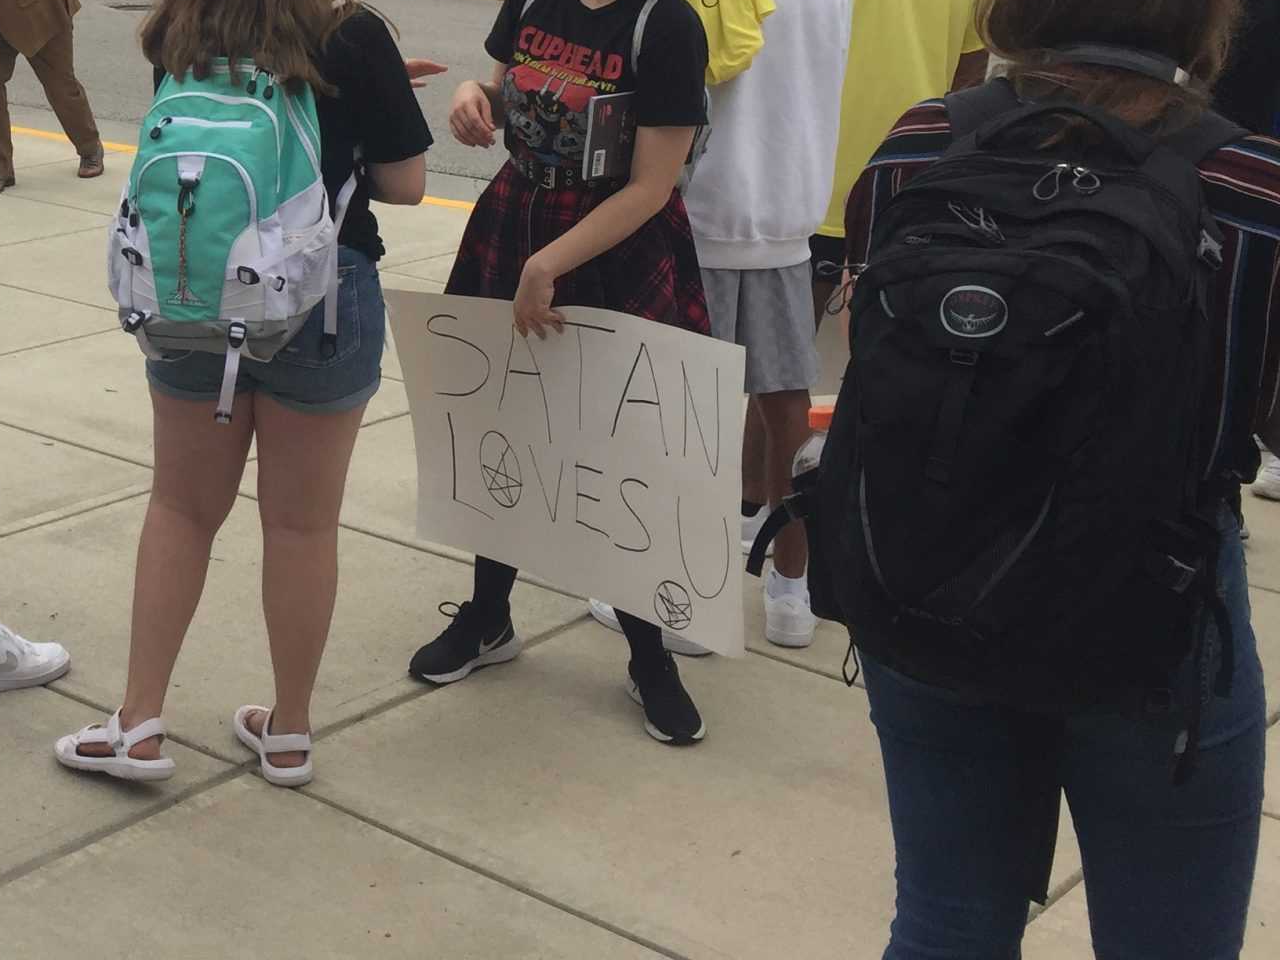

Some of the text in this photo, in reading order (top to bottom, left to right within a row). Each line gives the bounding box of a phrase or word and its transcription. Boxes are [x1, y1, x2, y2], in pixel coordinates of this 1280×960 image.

[518, 25, 624, 80] CUPHEAD
[426, 313, 721, 478] SATAN
[446, 411, 730, 600] LOVES U
